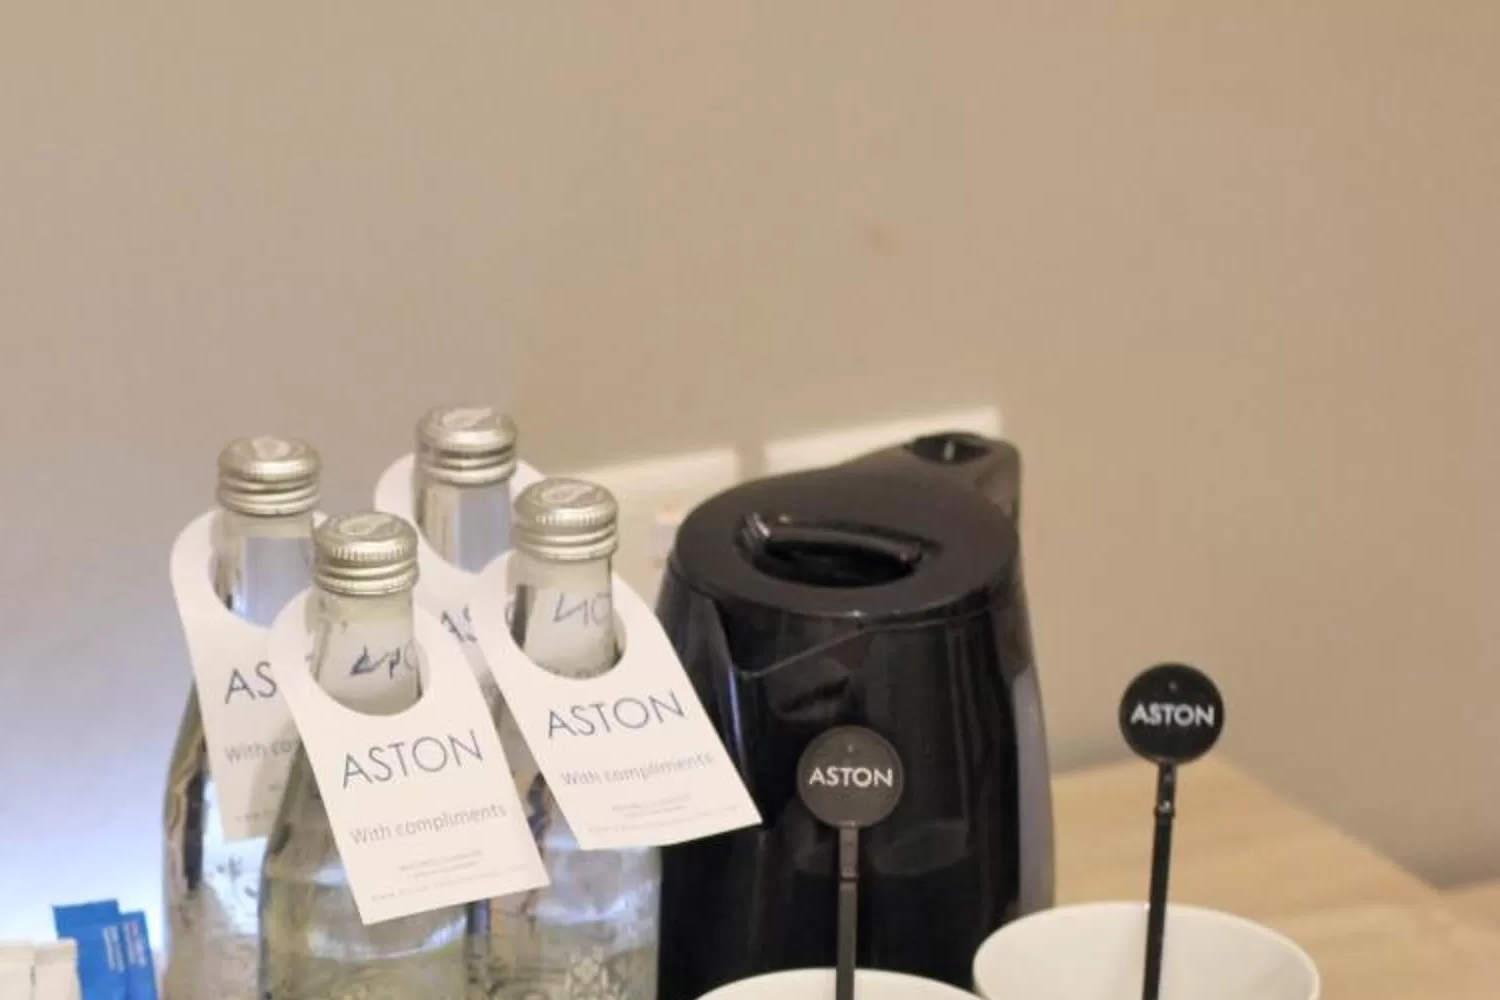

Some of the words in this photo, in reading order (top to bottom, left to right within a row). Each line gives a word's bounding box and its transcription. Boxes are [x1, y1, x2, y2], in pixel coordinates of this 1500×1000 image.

[548, 691, 686, 739] ASTON
[1130, 702, 1216, 727] ASTON
[342, 729, 484, 790] ASTON
[561, 766, 602, 785] With
[604, 752, 715, 783] compliments
[808, 765, 894, 788] ASTON
[350, 823, 392, 846] With
[395, 803, 507, 836] compliments
